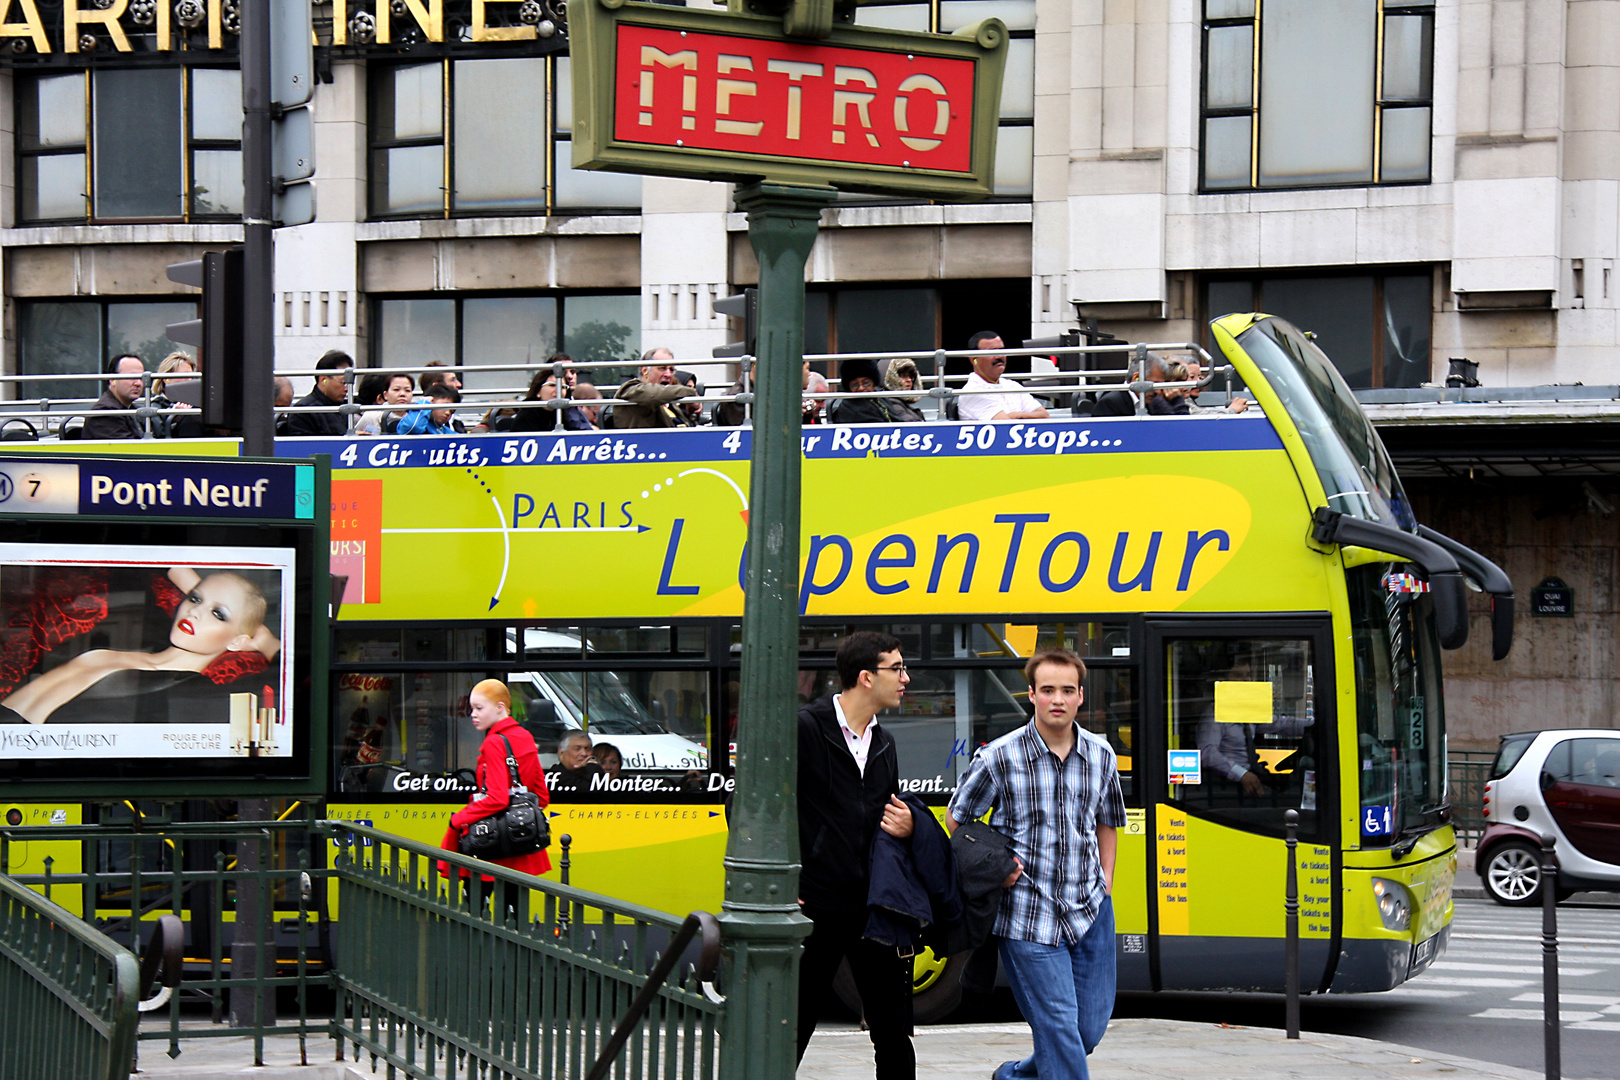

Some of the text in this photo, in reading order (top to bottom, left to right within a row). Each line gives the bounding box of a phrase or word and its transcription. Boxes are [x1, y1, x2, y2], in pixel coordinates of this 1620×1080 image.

[637, 45, 950, 151] METRO
[339, 437, 667, 467] 4 Ciruits, 50 Arrêts...
[722, 430, 742, 454] 4
[831, 427, 943, 454] Routes,
[955, 424, 997, 450] 50
[1005, 424, 1123, 455] Stops...
[28, 479, 42, 497] 7
[90, 474, 172, 506] Pont
[183, 478, 270, 508] Neuf
[1538, 605, 1566, 613] LOUVRE
[162, 733, 222, 742] ROUGE PUR
[173, 741, 222, 750] COUTURE
[393, 771, 430, 792] Get
[433, 776, 477, 792] on...
[544, 771, 577, 792] ff...
[589, 772, 681, 792] Monter...
